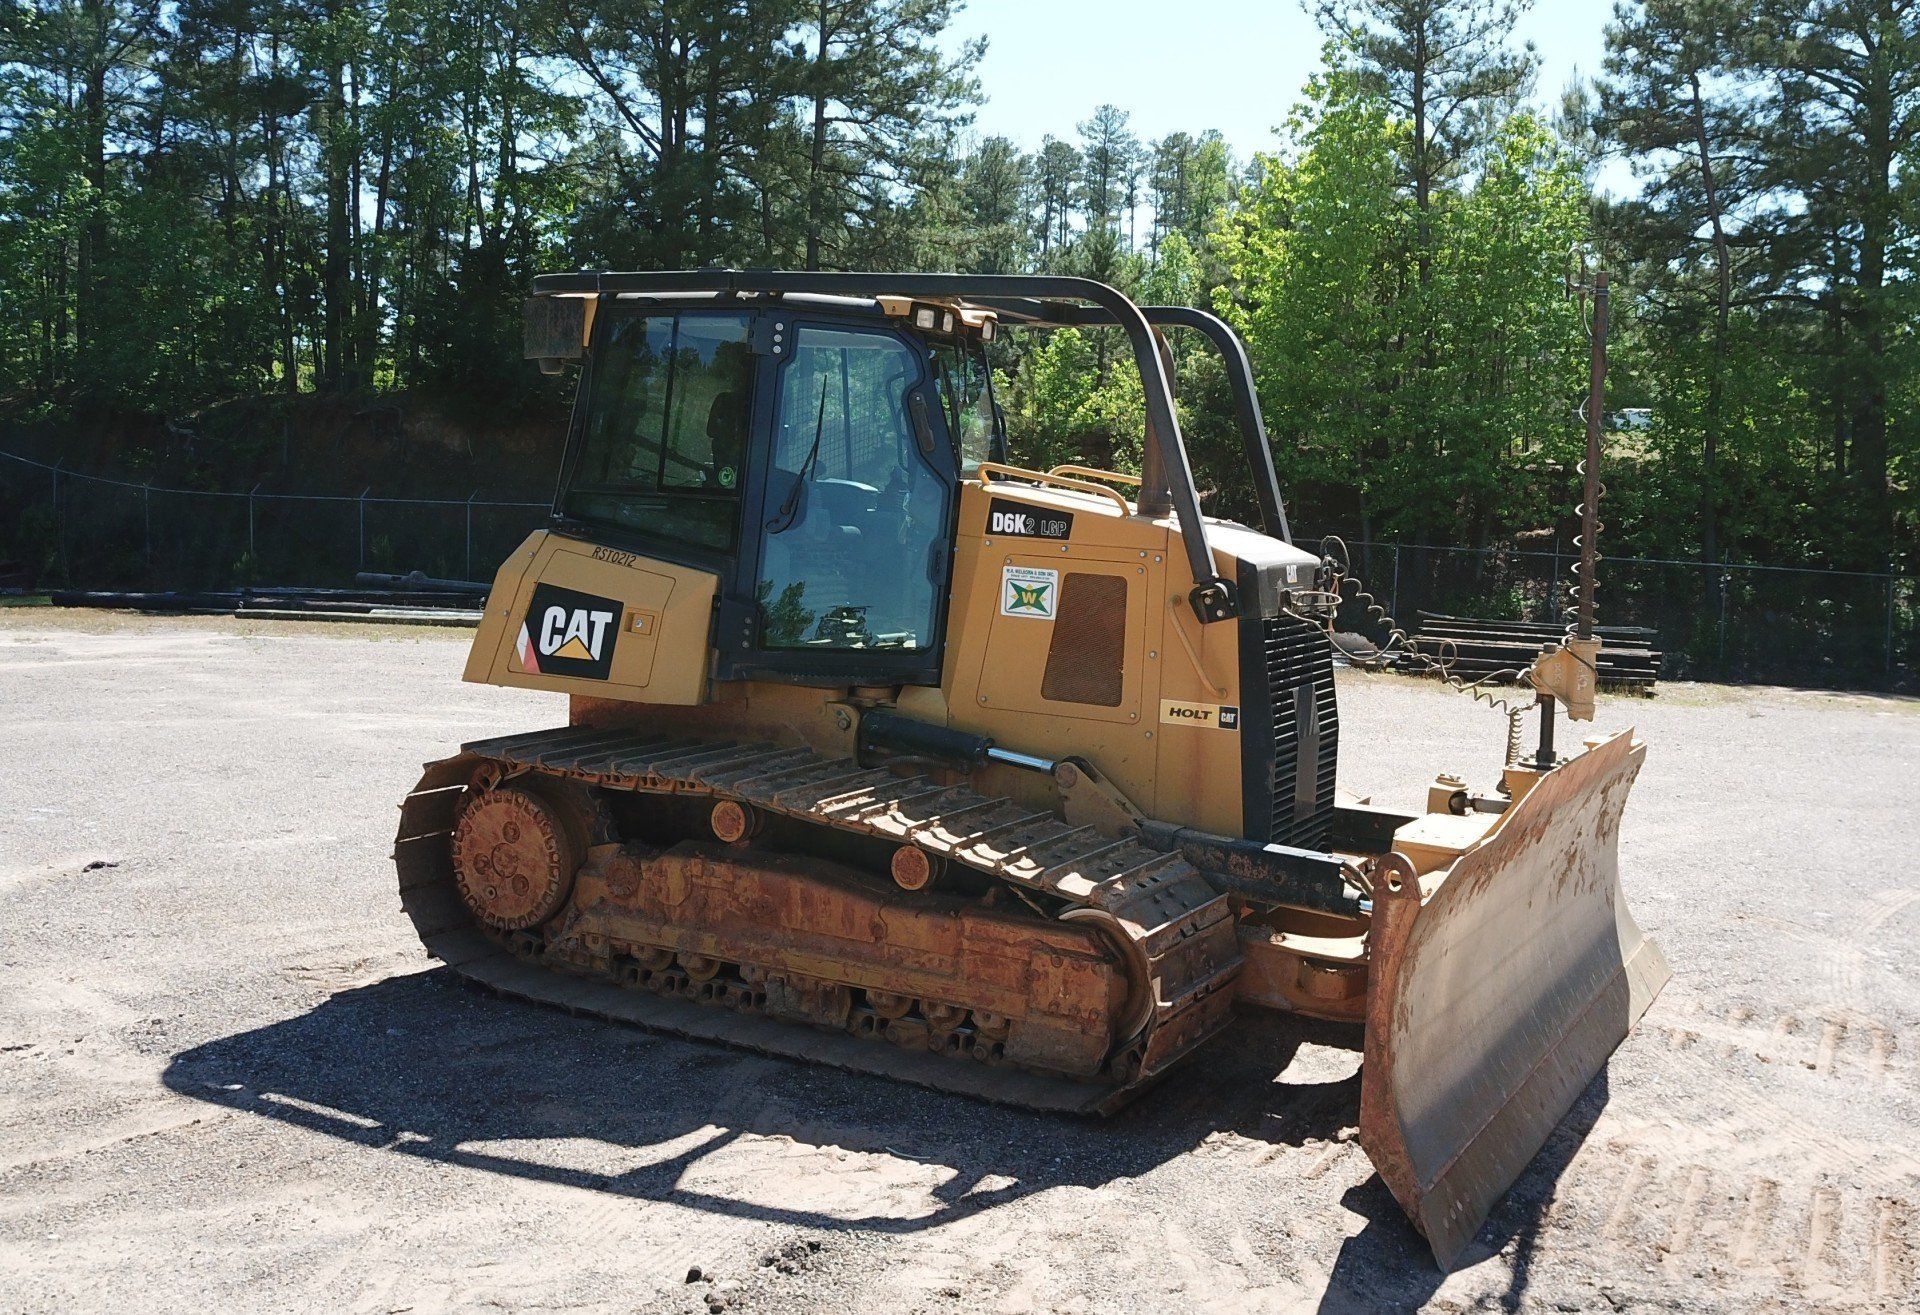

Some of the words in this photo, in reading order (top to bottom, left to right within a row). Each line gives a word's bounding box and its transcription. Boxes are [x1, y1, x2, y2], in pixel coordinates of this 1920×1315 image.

[1041, 520, 1067, 536] LGP
[592, 546, 636, 567] RST0212
[1021, 591, 1037, 604] W
[539, 605, 613, 661] CAT
[1169, 707, 1212, 720] HOLT
[1221, 712, 1236, 723] CAT
